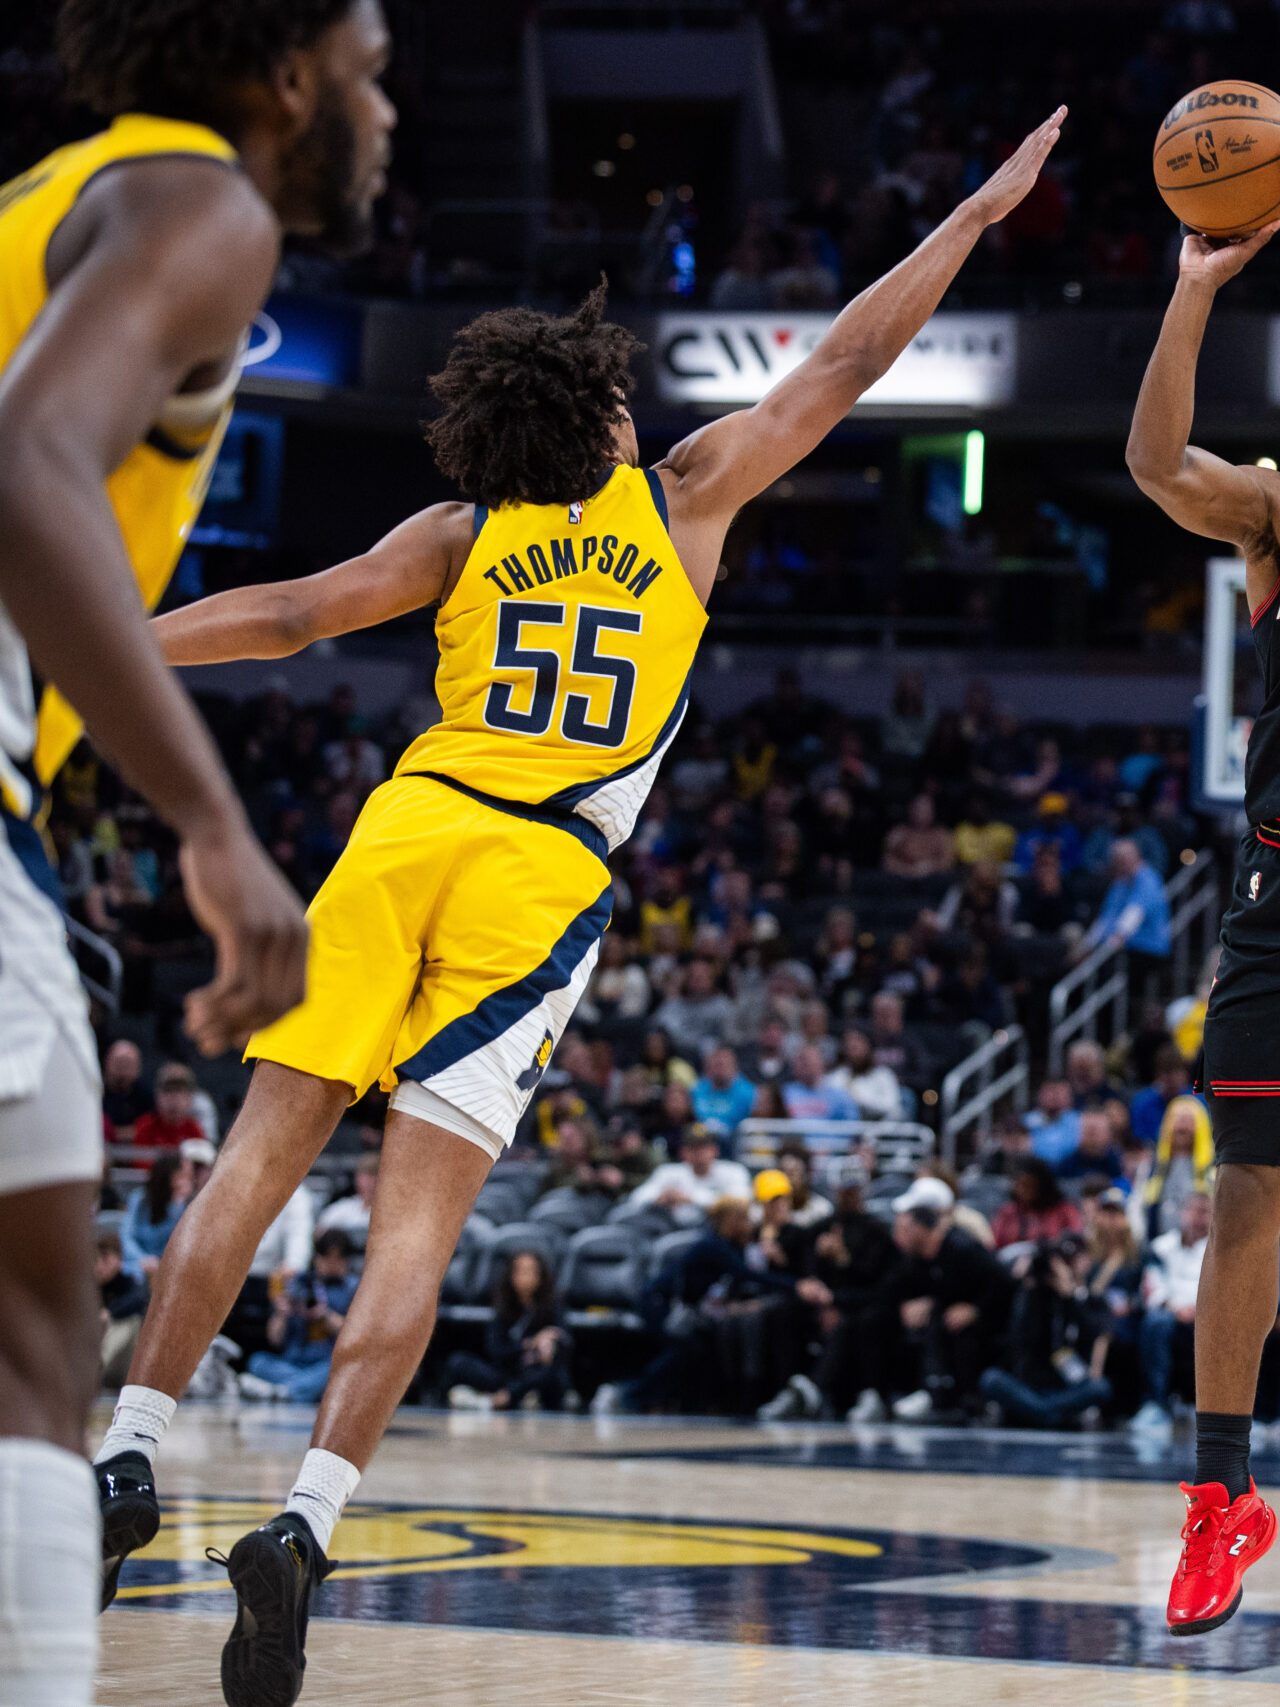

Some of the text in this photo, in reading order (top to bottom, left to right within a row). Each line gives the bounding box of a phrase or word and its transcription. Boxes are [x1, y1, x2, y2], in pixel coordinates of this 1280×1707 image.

[1165, 91, 1259, 130] Wilson
[483, 535, 663, 599] THOMPSON
[482, 598, 643, 749] 55
